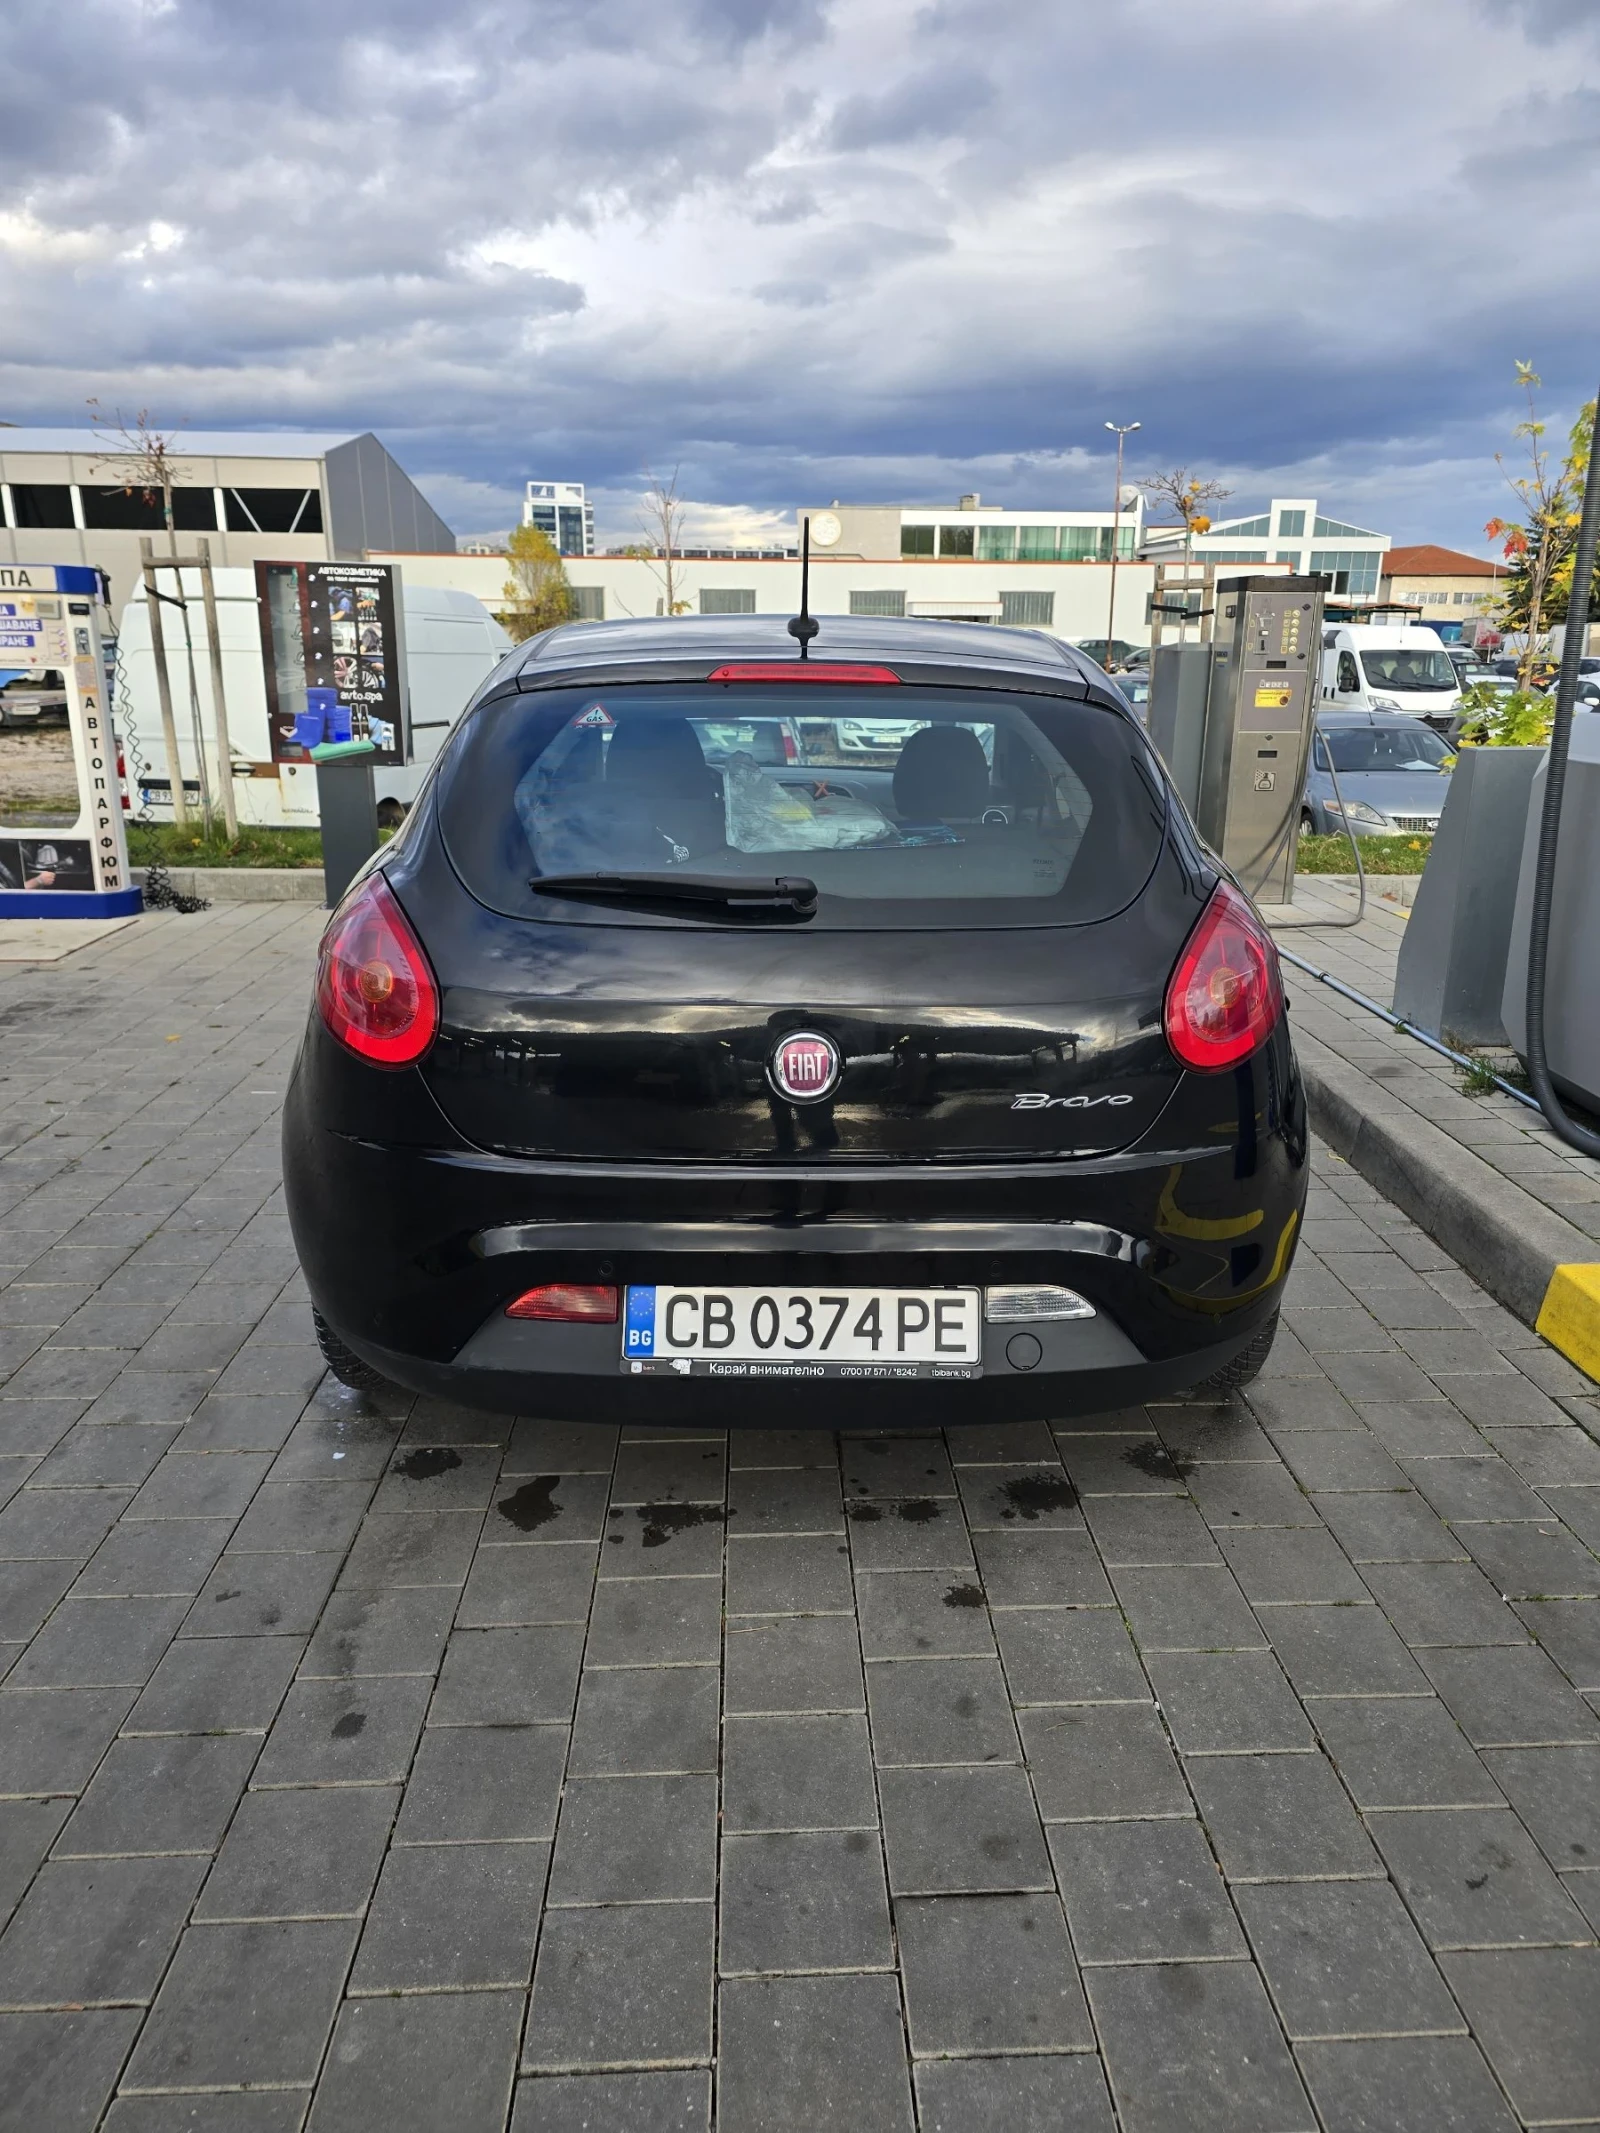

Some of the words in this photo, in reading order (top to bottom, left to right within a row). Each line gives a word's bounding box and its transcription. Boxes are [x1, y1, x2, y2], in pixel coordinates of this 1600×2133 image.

[318, 567, 387, 577] АВТОКОЗМЕТИКА
[85, 697, 118, 888] АВТОПАРФЮМ
[788, 1053, 824, 1081] FIAT
[1010, 1093, 1133, 1109] Bravo
[666, 1294, 735, 1348] CB
[751, 1295, 882, 1350] 0374
[897, 1297, 966, 1352] PE
[629, 1329, 652, 1346] BG
[709, 1363, 747, 1375] Карай
[750, 1365, 825, 1376] внимателно
[840, 1367, 861, 1376] 0700
[864, 1367, 872, 1376] 17
